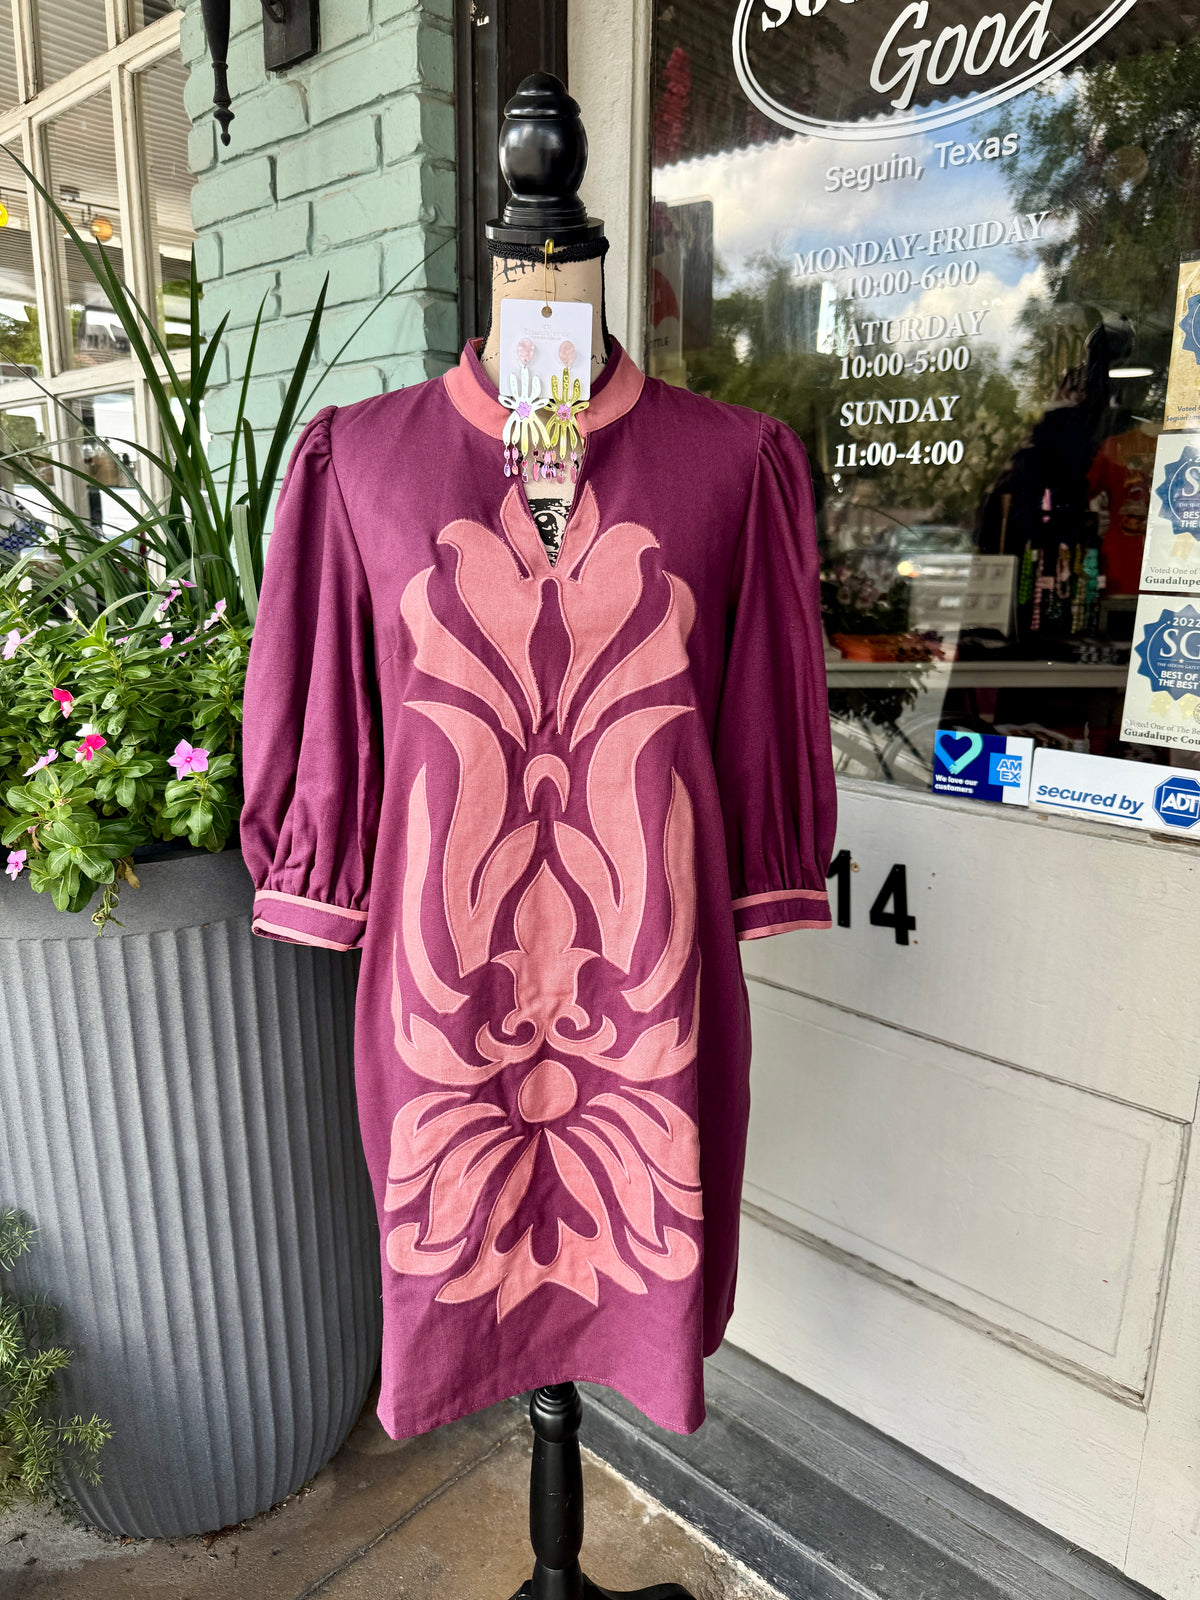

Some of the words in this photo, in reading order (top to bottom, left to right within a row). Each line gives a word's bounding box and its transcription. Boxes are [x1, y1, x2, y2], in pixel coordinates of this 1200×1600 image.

[869, 0, 1051, 110] Good
[824, 153, 925, 192] Seguin,
[934, 132, 1019, 169] Texas
[793, 211, 1050, 278] MONDAY-FRIDAY
[844, 260, 979, 301] 10:00-6:00
[838, 345, 971, 381] 10:00-5:00
[839, 395, 961, 428] SUNDAY
[834, 439, 964, 468] 11:00-4:00
[1150, 566, 1171, 574] Voted
[1172, 567, 1188, 575] One
[1189, 567, 1199, 575] of
[1145, 575, 1200, 588] Guadalupe
[1158, 678, 1176, 688] THE
[1176, 680, 1199, 690] BEST
[1160, 670, 1183, 680] BEST
[1184, 672, 1199, 682] OF
[1124, 728, 1178, 743] Guadalupe
[1129, 720, 1149, 728] Voted
[1150, 722, 1166, 731] One
[1175, 725, 1190, 734] The
[934, 783, 974, 794] customers
[935, 773, 948, 782] We
[948, 775, 964, 785] love
[964, 779, 979, 787] our
[1036, 784, 1117, 808] secured
[1119, 794, 1144, 815] by
[1161, 792, 1200, 813] ADT
